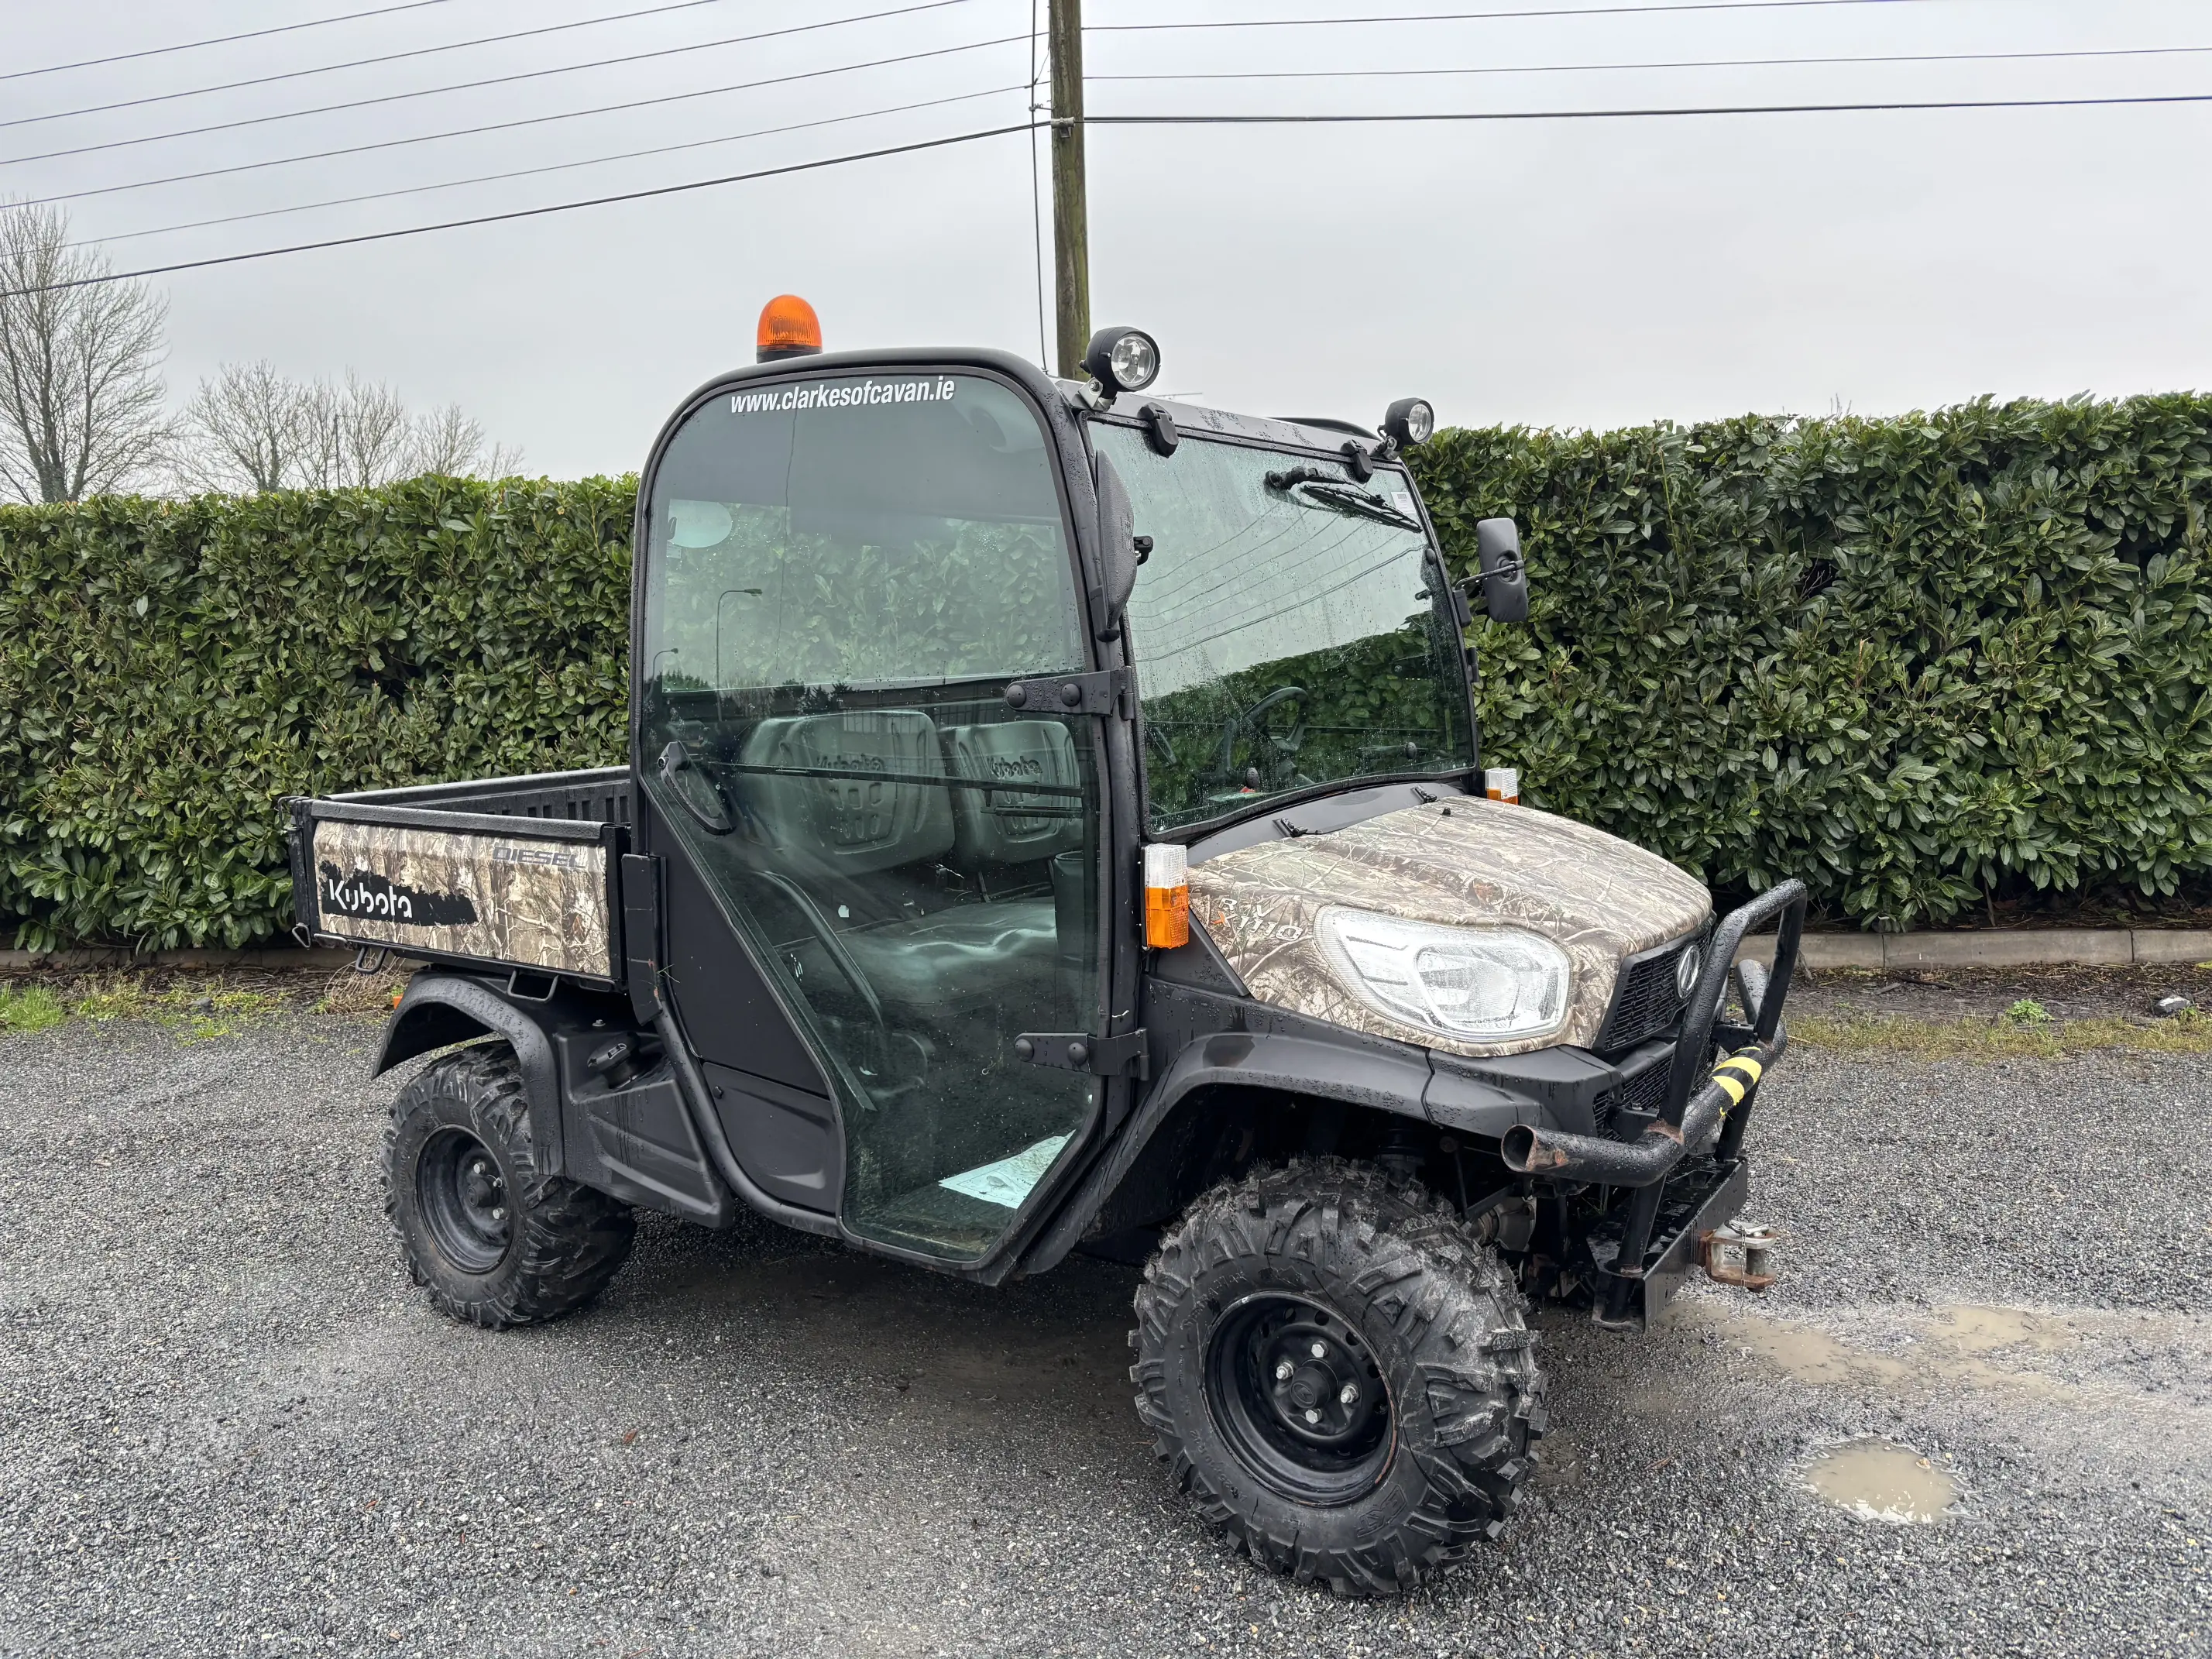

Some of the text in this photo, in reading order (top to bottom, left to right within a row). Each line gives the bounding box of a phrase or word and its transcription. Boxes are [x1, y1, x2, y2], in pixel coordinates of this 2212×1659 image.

[730, 376, 955, 413] www.clarkesofcavan.ie
[492, 847, 586, 869] DIESEL
[328, 878, 413, 919] Kubota
